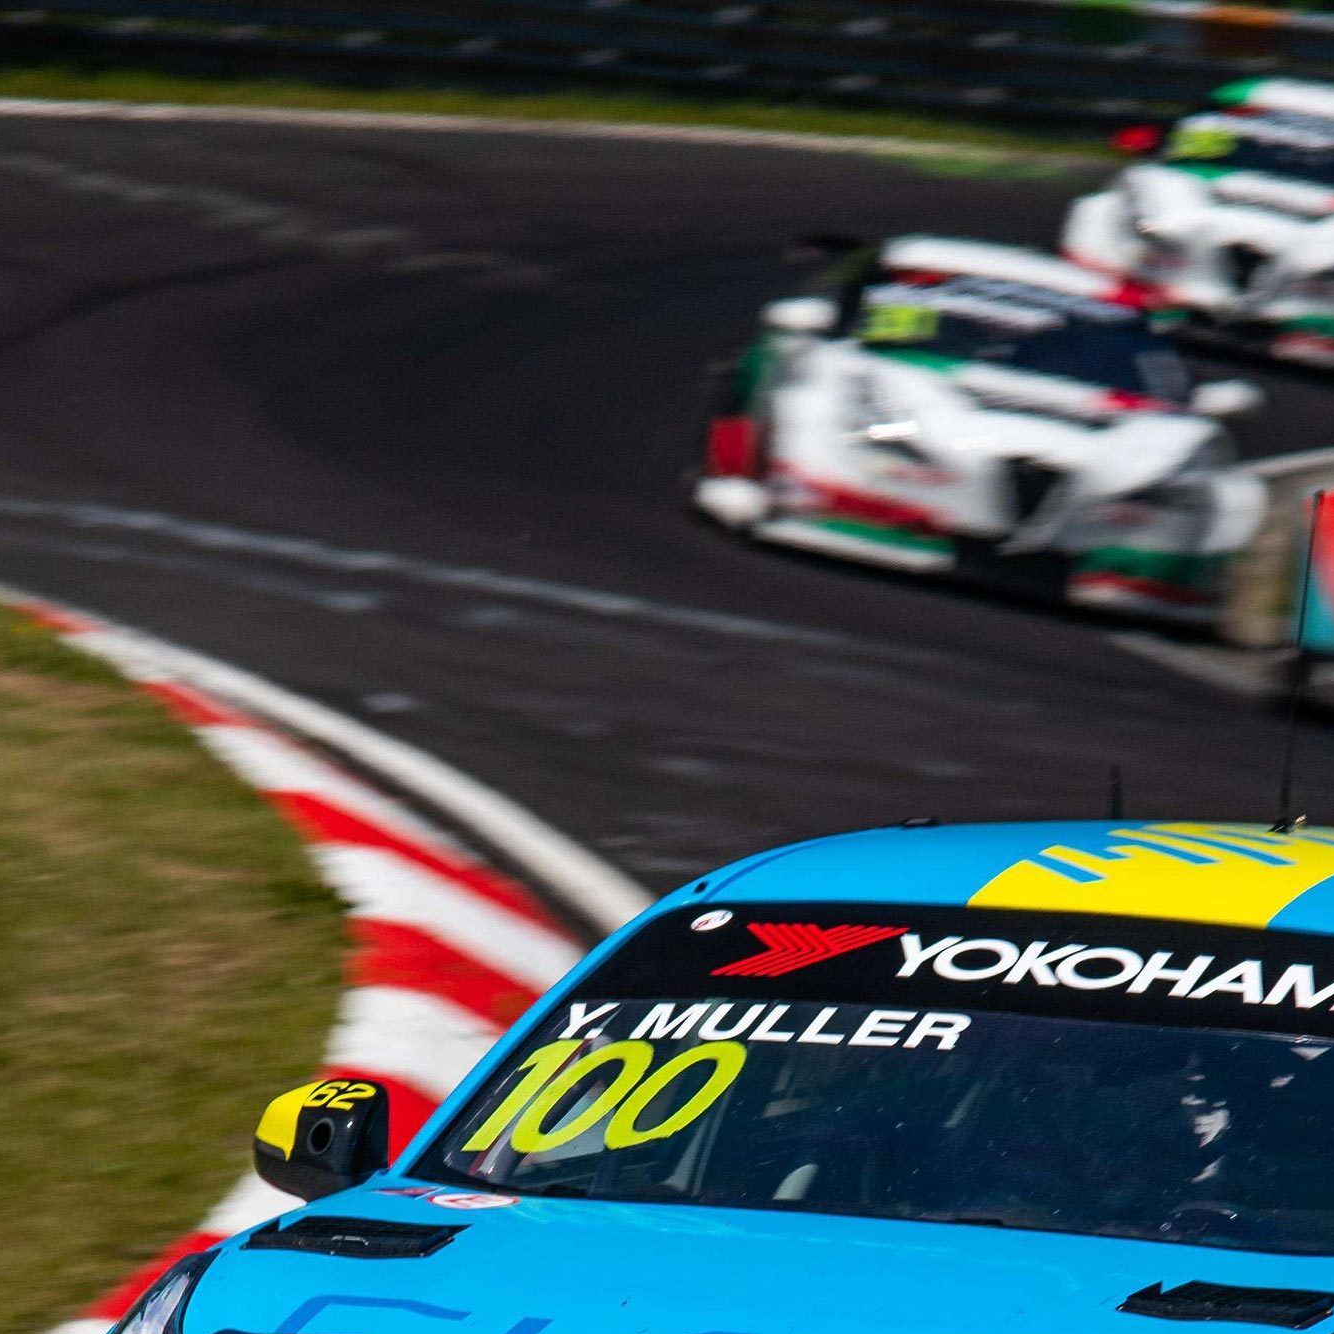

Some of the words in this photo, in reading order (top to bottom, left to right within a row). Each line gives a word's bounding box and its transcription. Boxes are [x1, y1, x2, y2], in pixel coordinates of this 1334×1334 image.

[558, 1001, 622, 1041] Y.
[634, 1003, 973, 1051] MULLER
[303, 1081, 377, 1111] 62
[461, 1038, 748, 1154] 100
